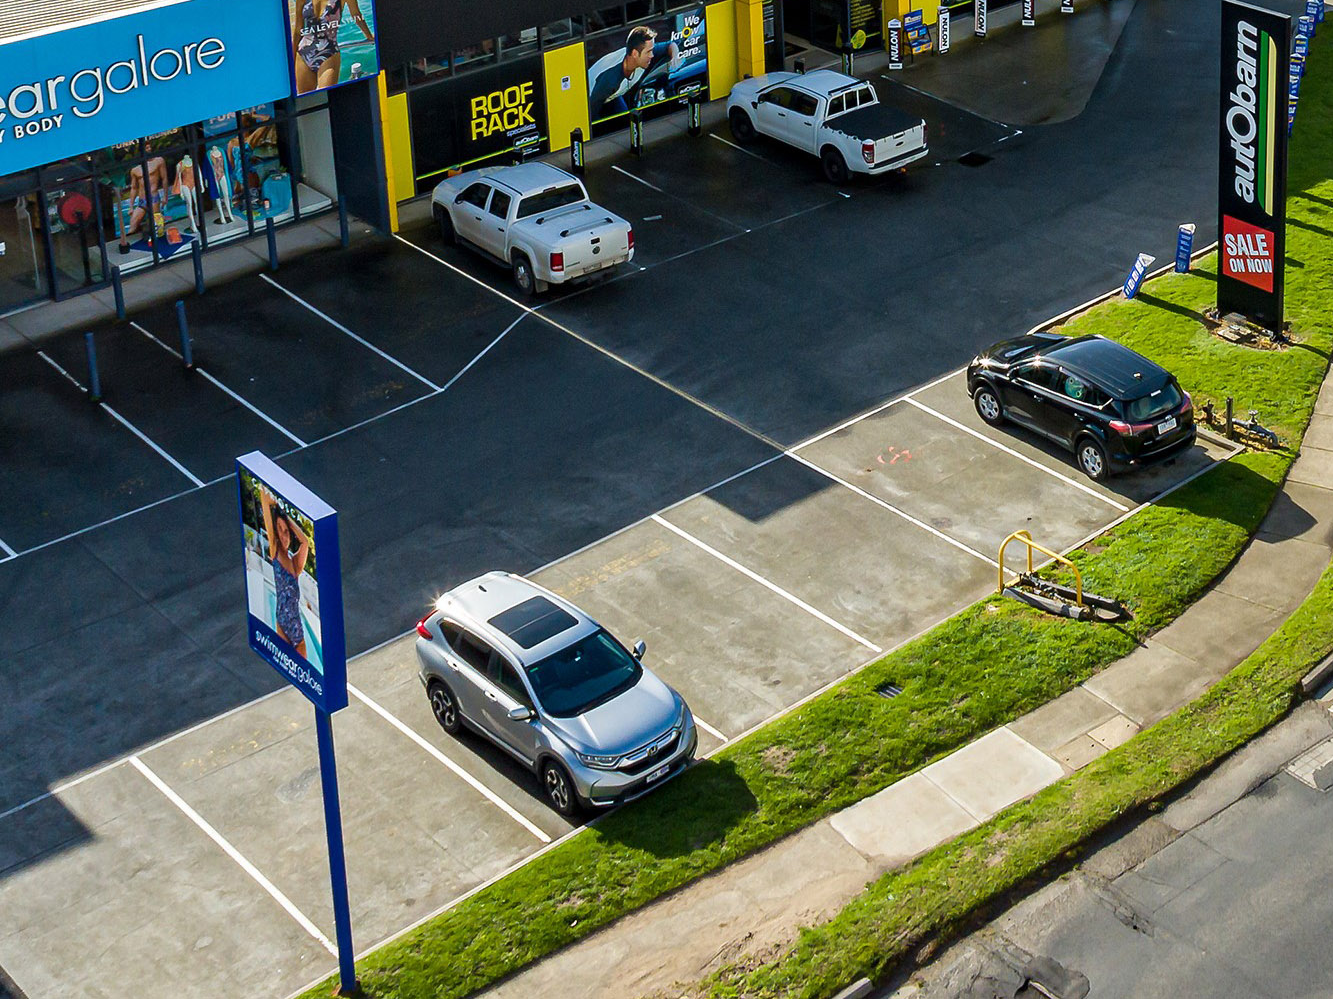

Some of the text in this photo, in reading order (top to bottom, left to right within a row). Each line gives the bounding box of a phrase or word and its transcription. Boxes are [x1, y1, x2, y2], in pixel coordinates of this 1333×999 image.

[300, 25, 317, 37] SEA
[316, 19, 341, 32] LEVEL
[684, 15, 700, 28] We
[670, 25, 700, 42] know
[683, 35, 700, 48] car
[677, 47, 702, 60] care.
[890, 30, 899, 62] NULON
[470, 81, 534, 119] ROOF
[14, 114, 64, 140] BODY
[470, 102, 536, 141] RACK
[1224, 232, 1270, 257] SALE
[1229, 257, 1273, 273] ON NOW
